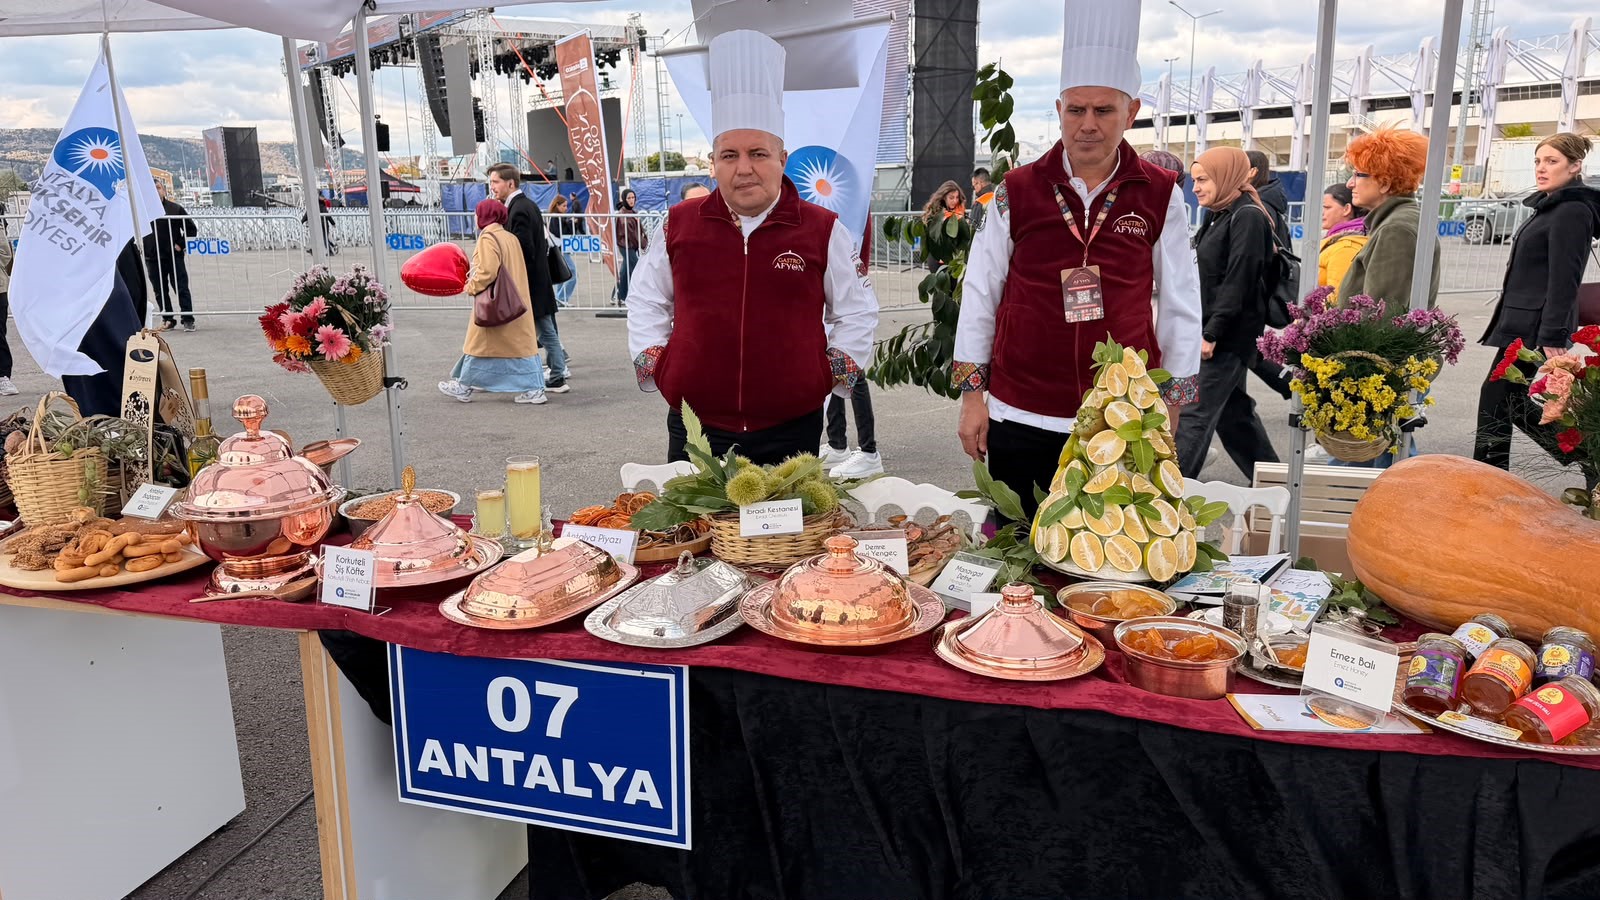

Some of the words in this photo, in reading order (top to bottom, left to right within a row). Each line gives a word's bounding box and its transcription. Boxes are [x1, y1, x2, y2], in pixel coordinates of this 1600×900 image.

[1118, 220, 1144, 228] GASTRO
[1437, 220, 1466, 236] OLIS
[1113, 225, 1147, 236] AFYON
[774, 262, 804, 272] AFYON
[777, 257, 802, 265] GASTRO
[767, 505, 799, 513] Kestanesi
[598, 533, 622, 545] Piyazı
[864, 543, 886, 551] Demre
[335, 554, 367, 567] Korkuteli
[345, 565, 366, 577] Köfte
[954, 565, 984, 578] Manavgat
[1330, 647, 1356, 665] Ernez
[1358, 655, 1376, 671] Balı
[1333, 660, 1350, 672] Ernez
[1350, 666, 1369, 678] Honey
[486, 676, 580, 739] 07
[417, 738, 664, 810] ANTALYA
